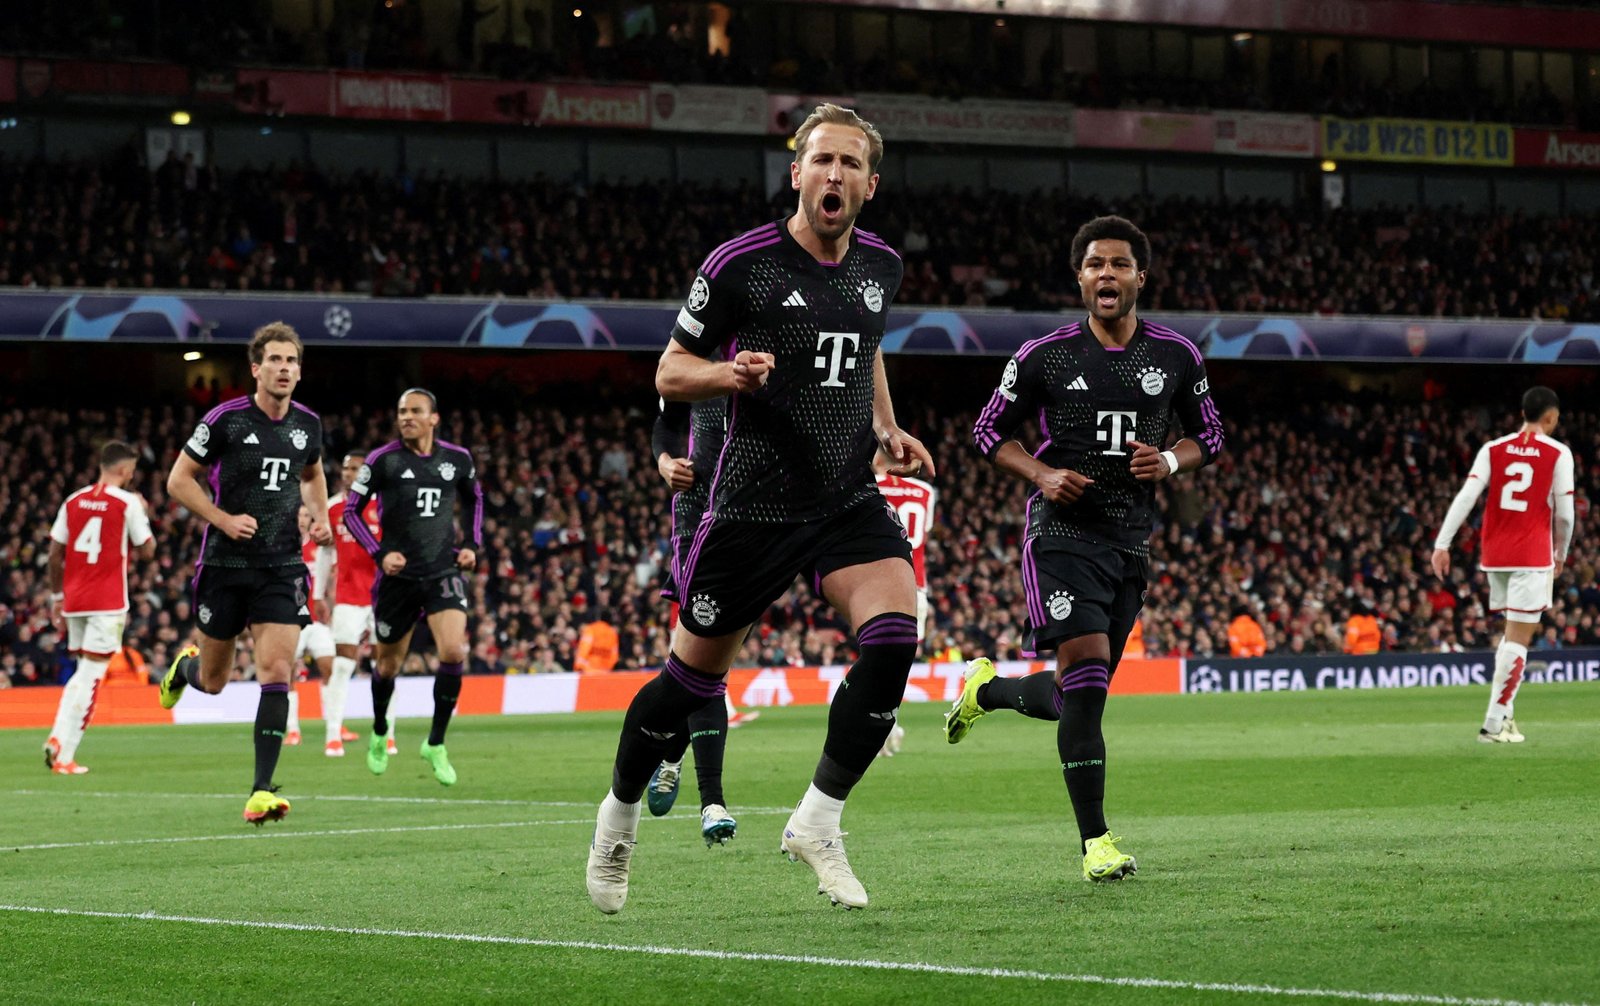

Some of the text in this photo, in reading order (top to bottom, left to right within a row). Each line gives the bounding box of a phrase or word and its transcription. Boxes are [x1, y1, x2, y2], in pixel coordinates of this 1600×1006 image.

[540, 88, 648, 126] Arsenal
[1326, 121, 1370, 153] P38
[1377, 123, 1426, 156] W26
[1434, 125, 1478, 158] D12
[814, 331, 860, 389] T
[1096, 411, 1137, 456] T
[259, 457, 291, 492] T
[1499, 461, 1534, 513] 2
[78, 499, 109, 513] WHITE
[416, 487, 442, 517] T
[73, 516, 104, 565] 4
[886, 501, 926, 550] 0
[439, 576, 466, 599] 10
[1228, 668, 1307, 692] UEFA
[1315, 662, 1487, 690] CHAMPIONS
